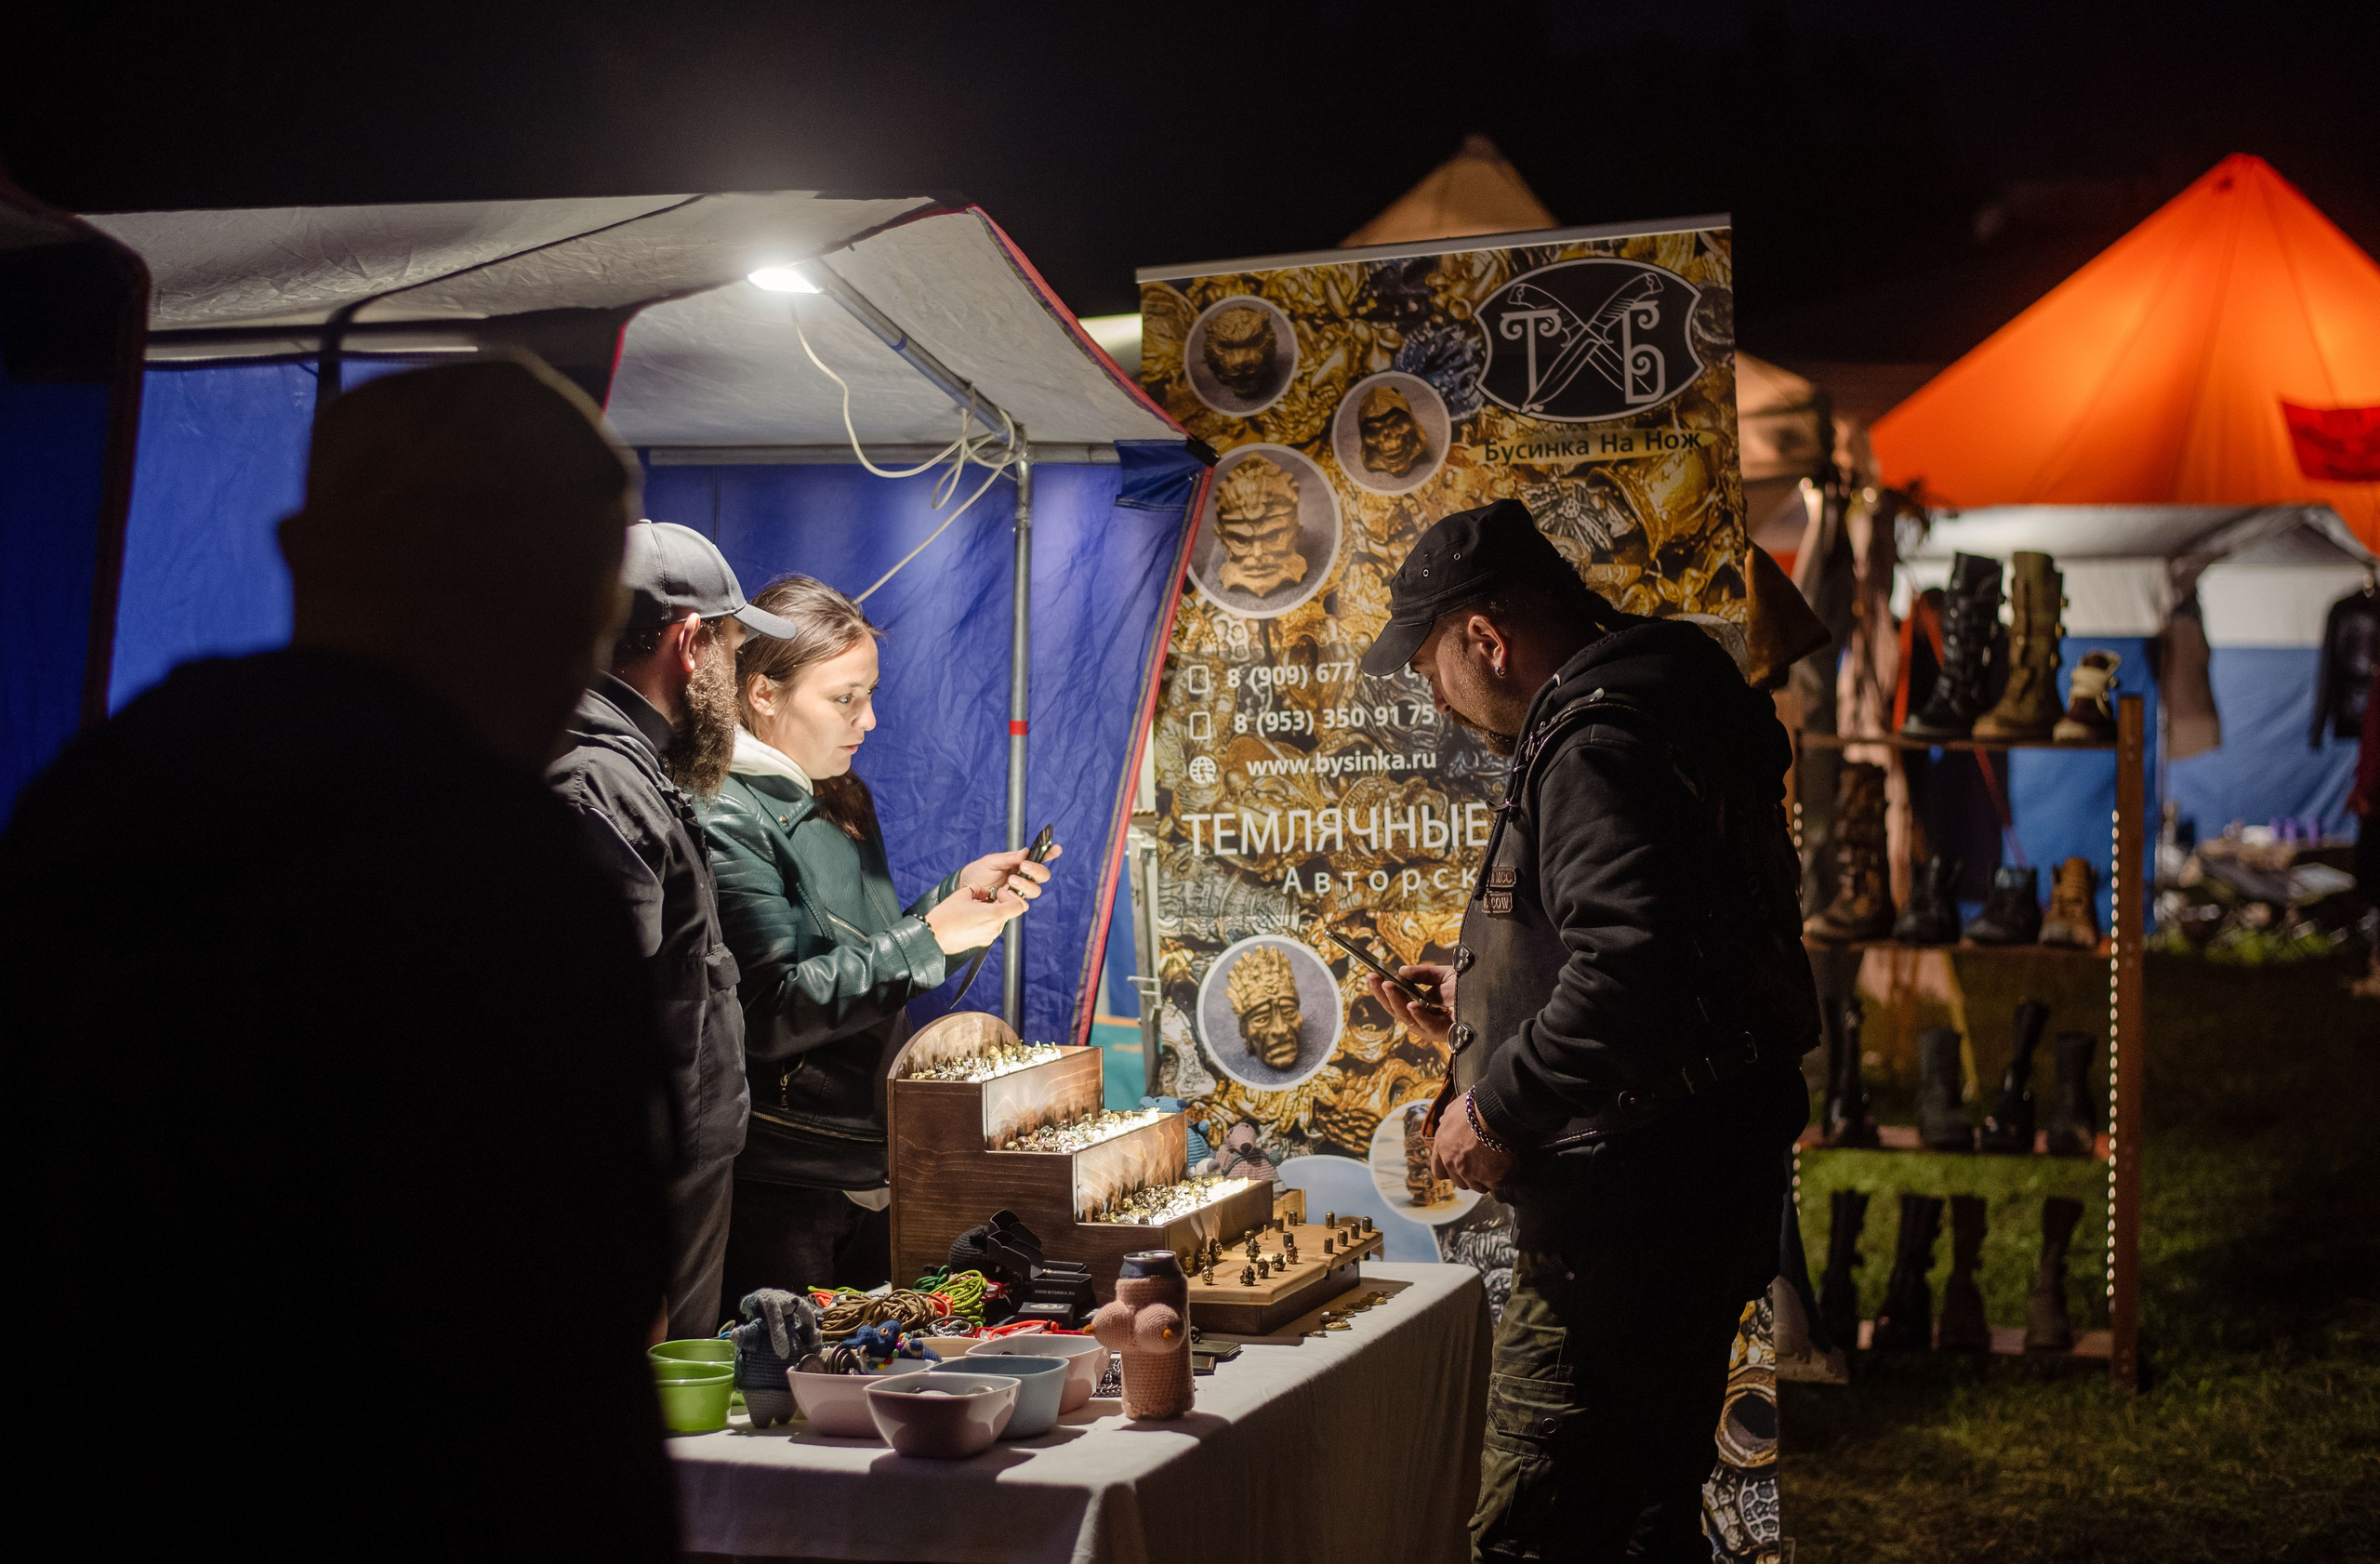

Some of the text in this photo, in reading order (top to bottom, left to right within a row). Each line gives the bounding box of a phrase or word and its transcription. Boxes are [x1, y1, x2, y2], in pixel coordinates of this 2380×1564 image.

[1485, 430, 1703, 465] Бусинка На Нож
[1226, 670, 1241, 689] 8
[1249, 664, 1308, 692] (909)
[1316, 662, 1355, 683] 677
[1234, 704, 1435, 736] 8 (953) 350 91 75
[1247, 750, 1437, 778] www.bysinka.ru
[1182, 803, 1488, 856] ТЕМЛЯЧНЫЕ
